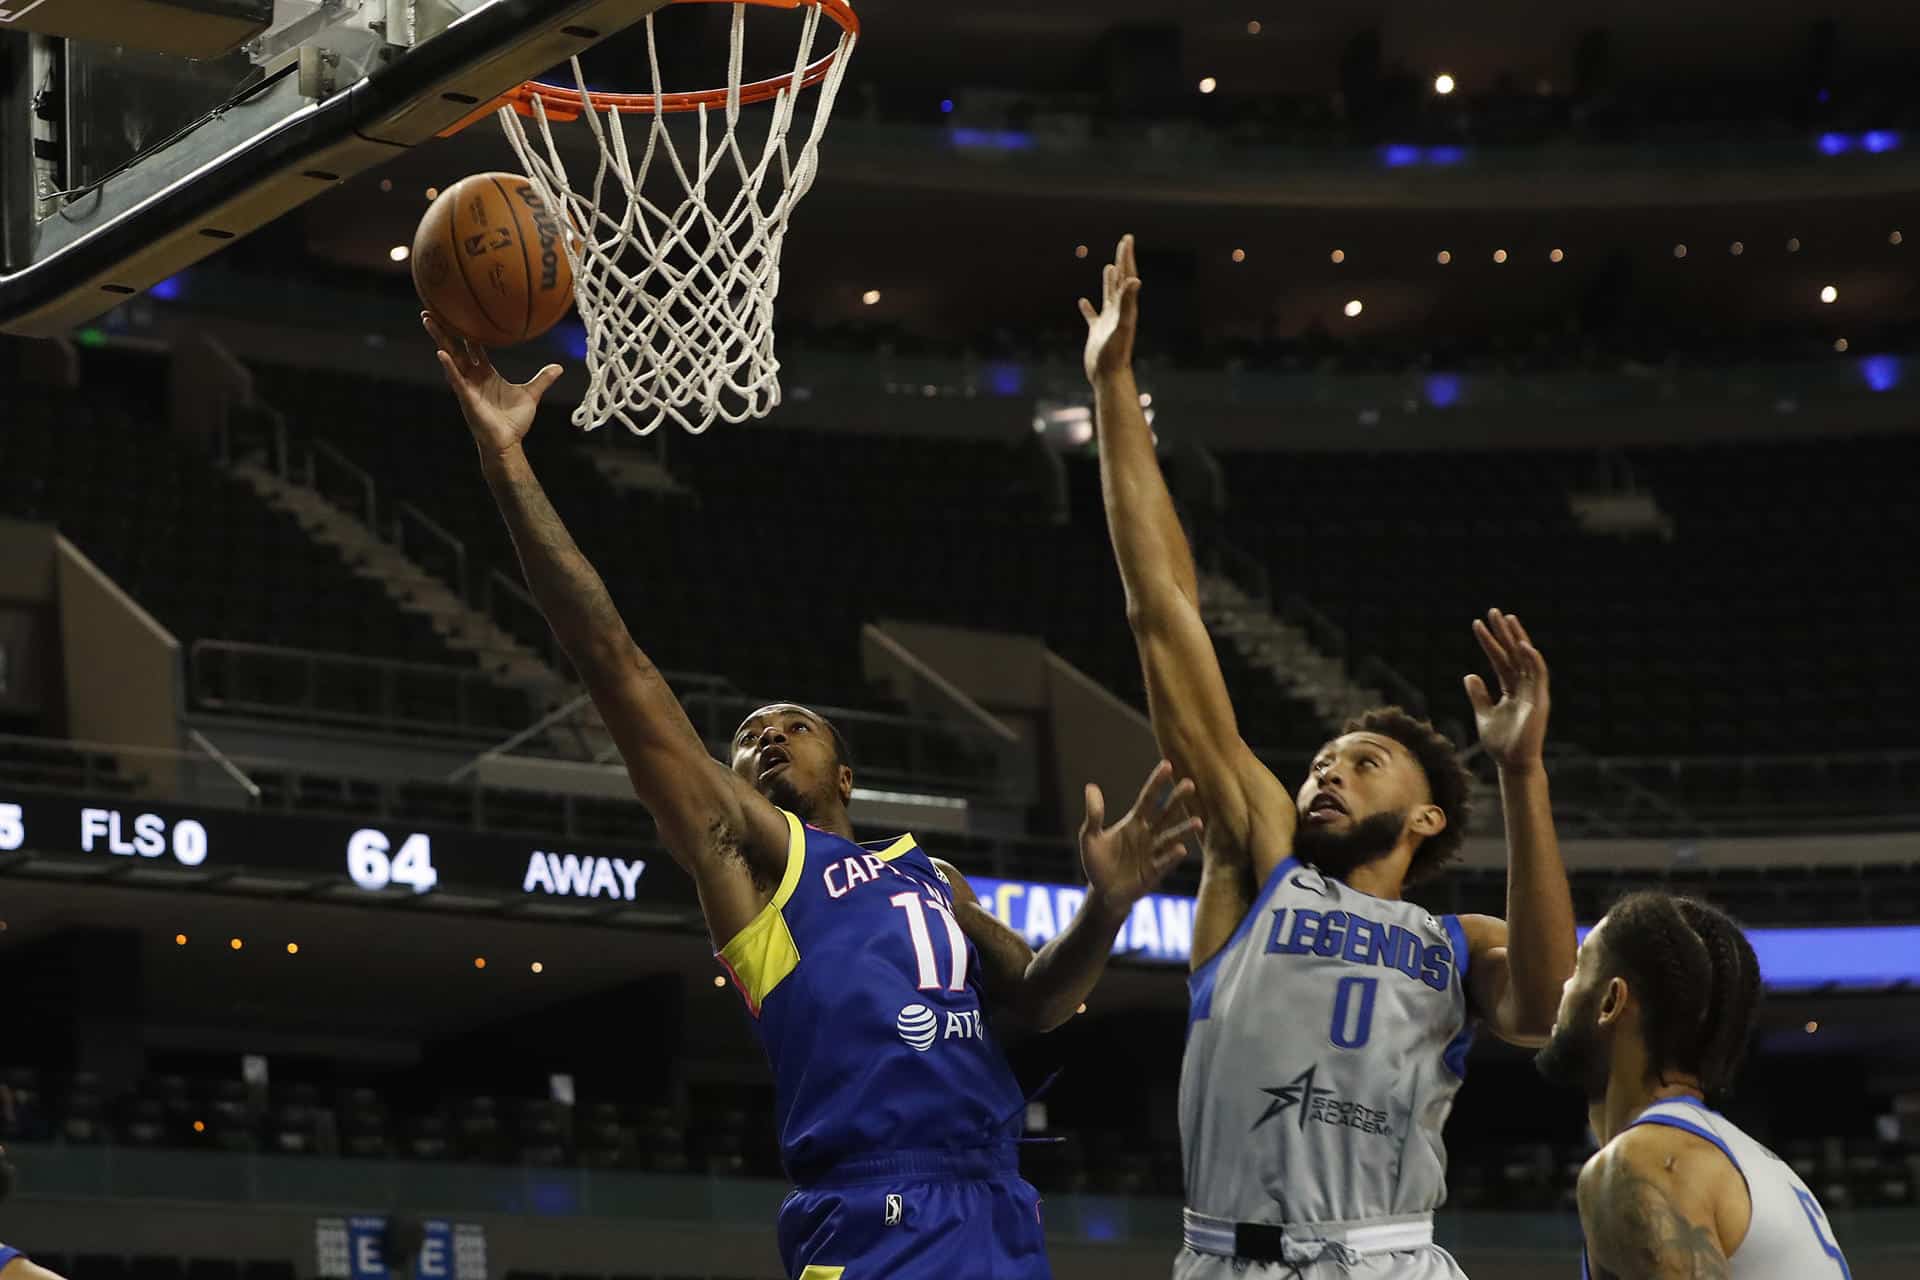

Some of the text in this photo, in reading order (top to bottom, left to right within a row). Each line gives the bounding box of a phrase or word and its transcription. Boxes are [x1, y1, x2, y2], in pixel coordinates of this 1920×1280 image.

[81, 808, 166, 857] FLS
[172, 820, 207, 866] 0
[347, 829, 437, 894] 64
[523, 851, 646, 900] AWAY
[1264, 908, 1452, 992] LEGENDS
[1329, 976, 1379, 1050] 0
[1312, 1096, 1389, 1124] SPORTS
[420, 1239, 447, 1276] E
